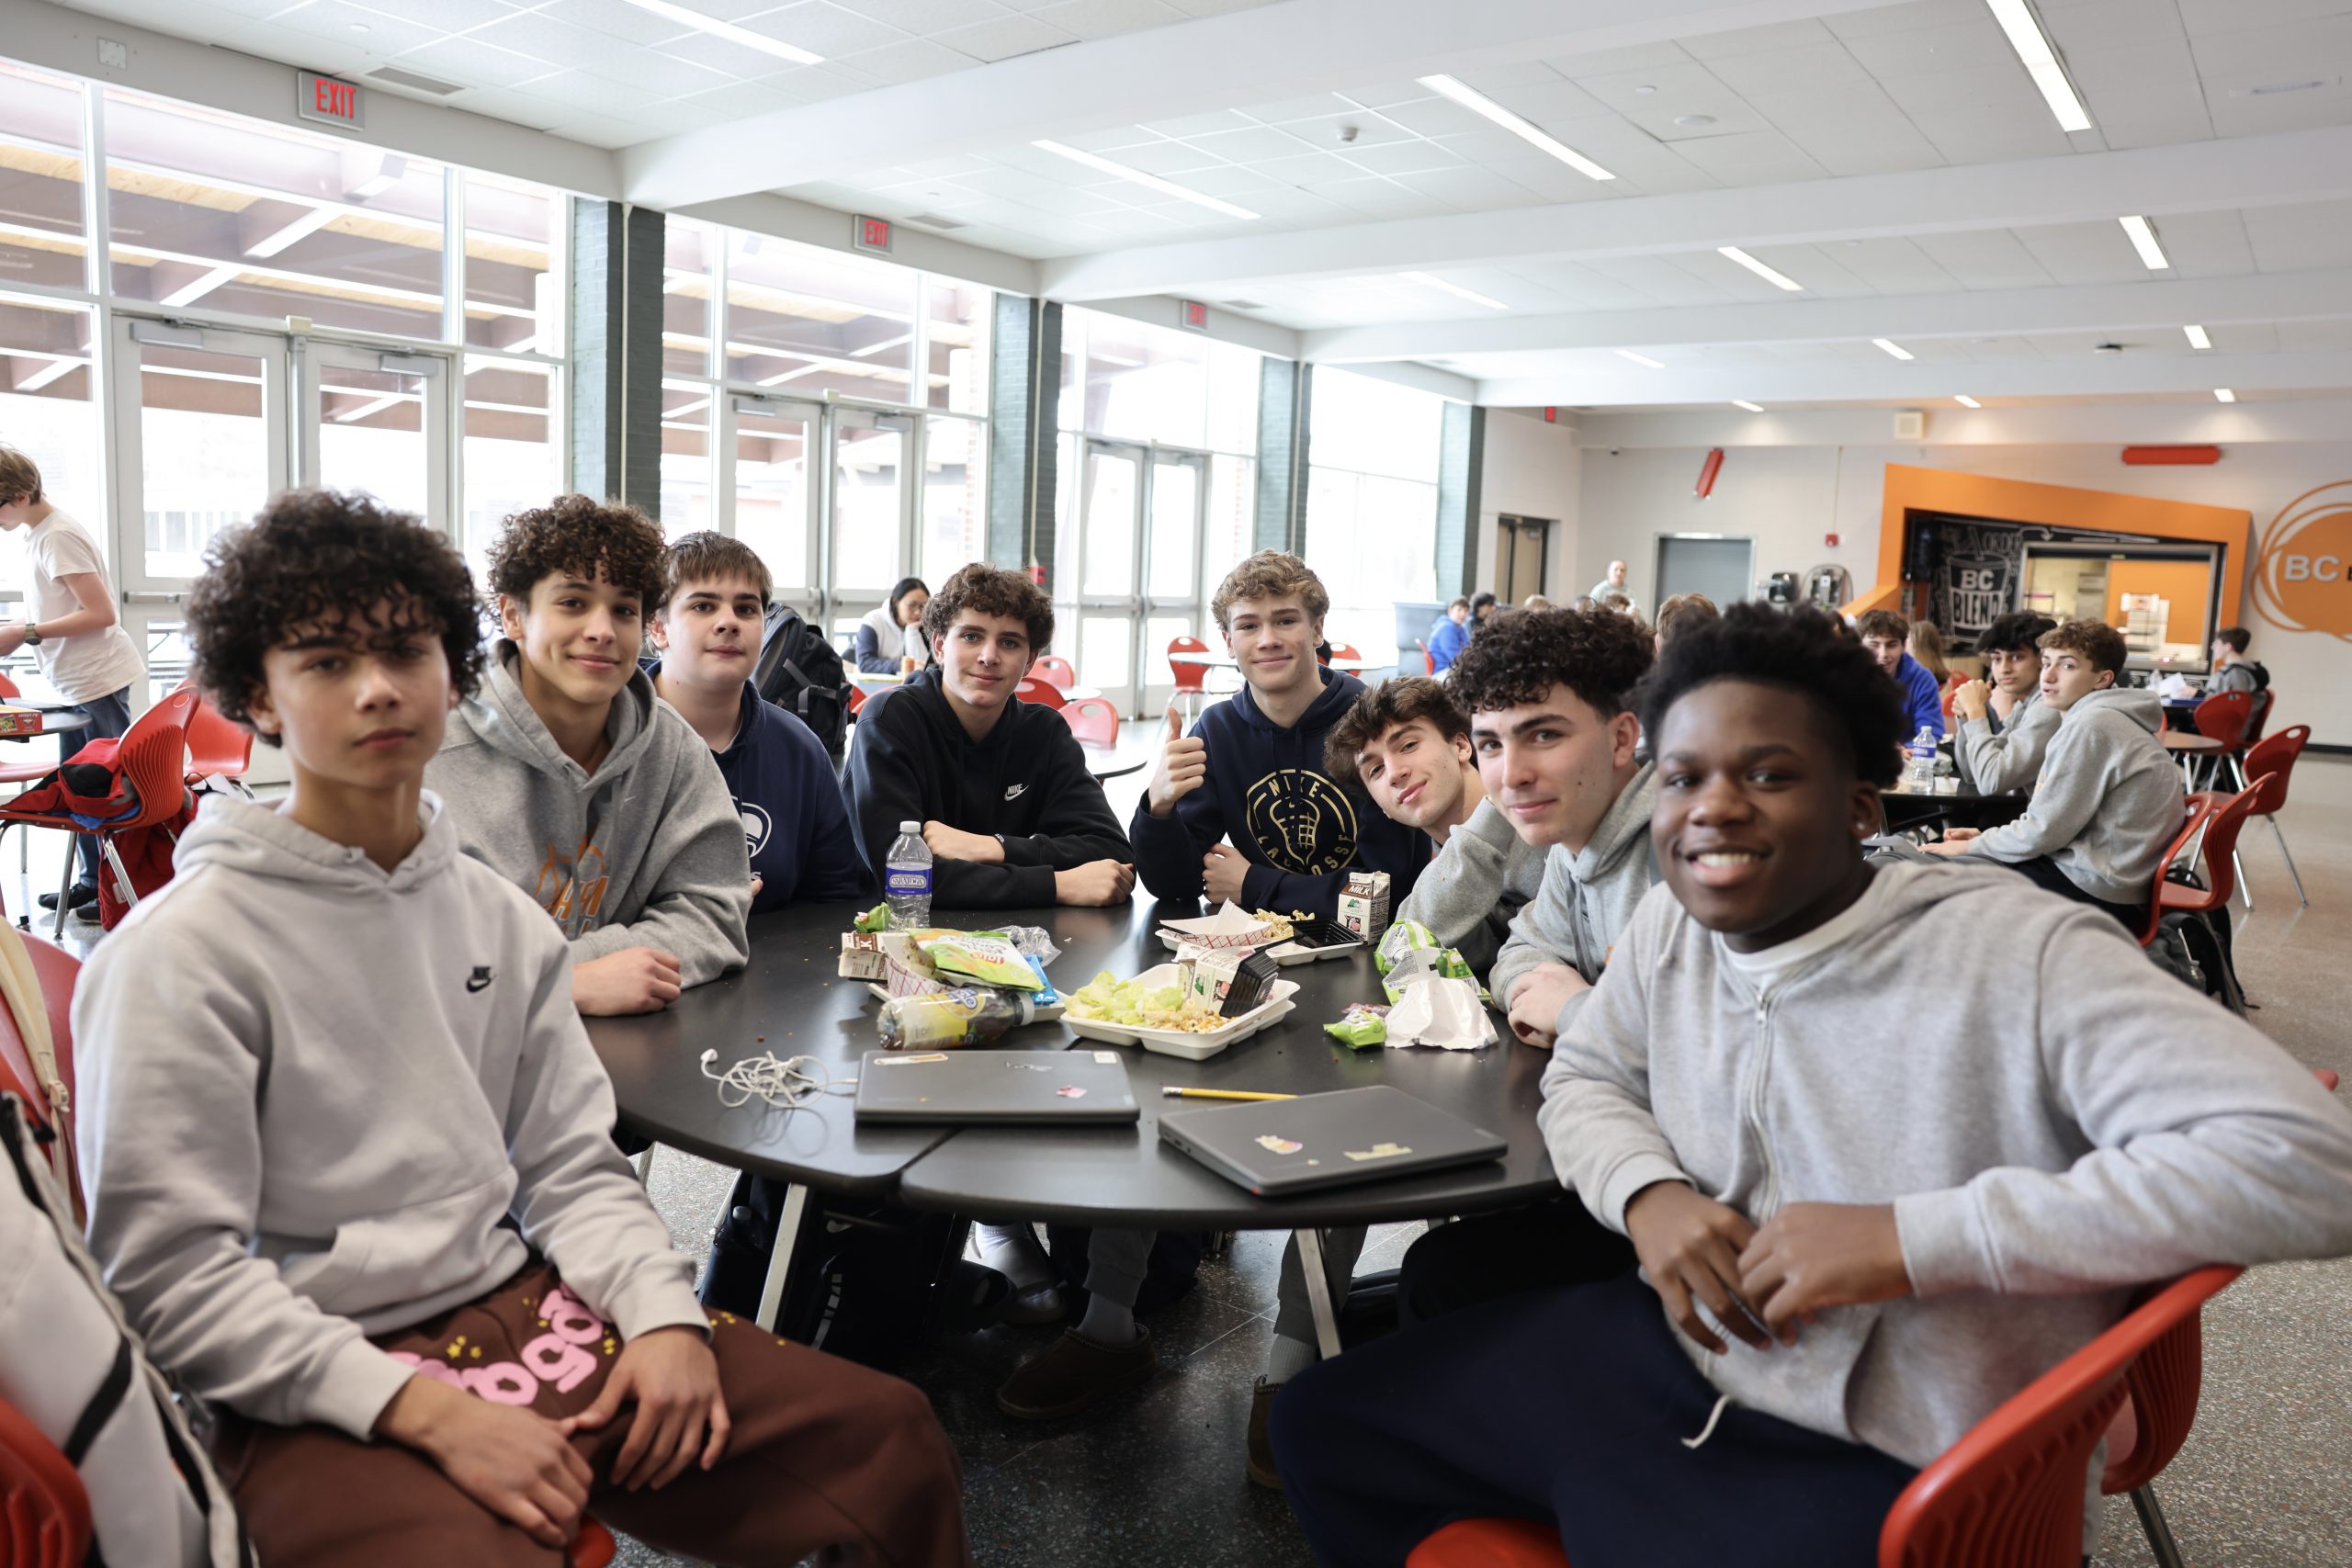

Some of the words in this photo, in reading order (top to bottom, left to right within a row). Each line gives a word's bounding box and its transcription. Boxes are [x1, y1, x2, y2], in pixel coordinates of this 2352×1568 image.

[315, 78, 356, 119] EXIT
[865, 220, 888, 248] EXIT
[1961, 570, 1995, 591] BC
[2285, 555, 2341, 582] BC
[1007, 783, 1023, 795] NIKE
[1258, 833, 1354, 876] LAOSS
[1348, 885, 1371, 897] MILK
